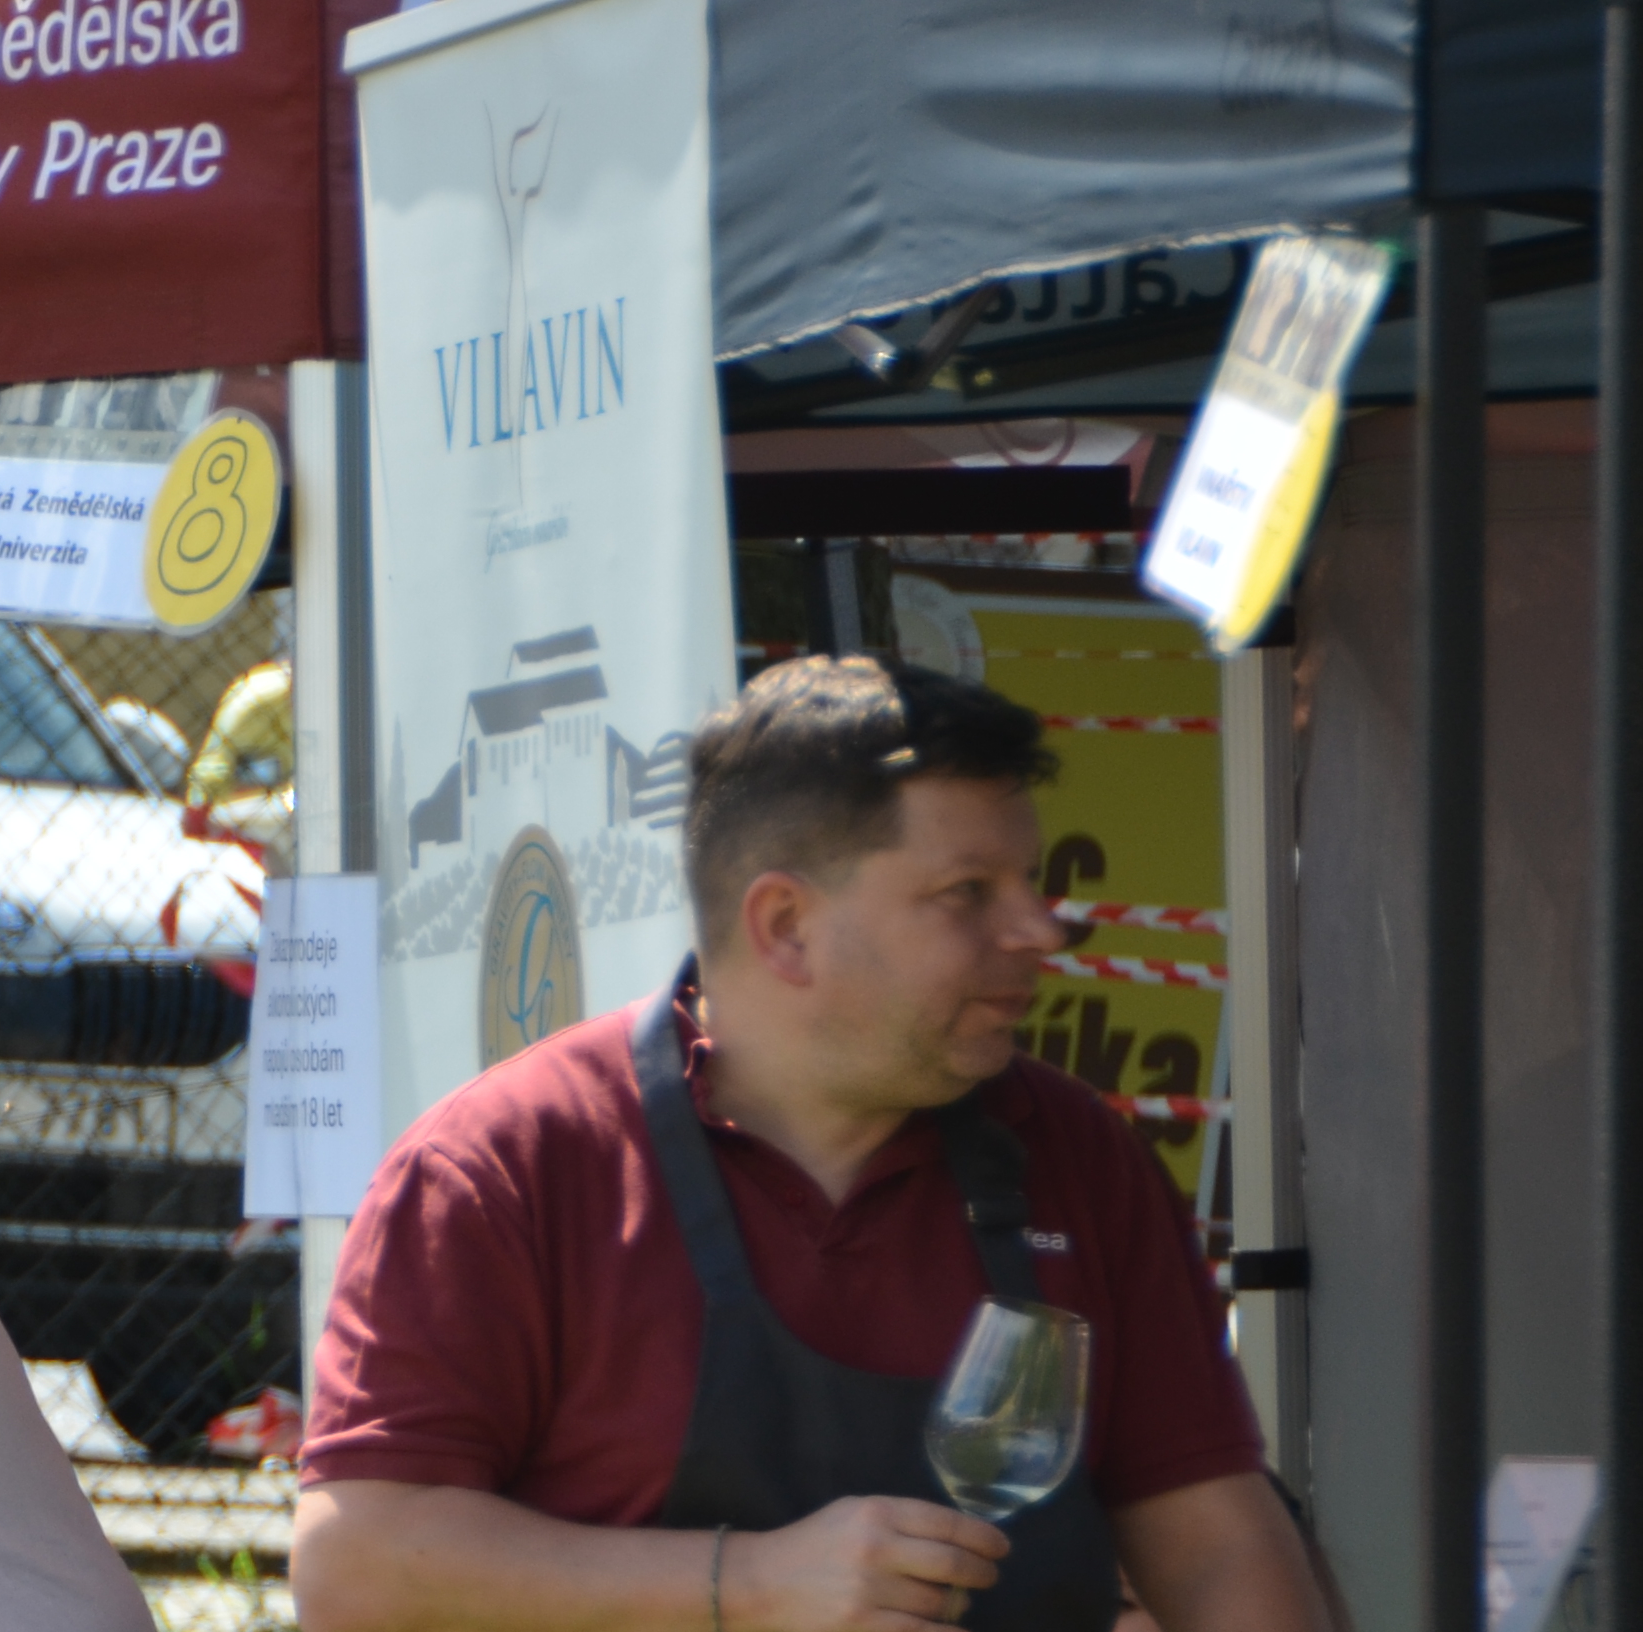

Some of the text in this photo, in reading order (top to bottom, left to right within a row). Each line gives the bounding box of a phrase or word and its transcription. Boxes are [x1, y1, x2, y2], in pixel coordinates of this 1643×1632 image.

[33, 119, 225, 199] Praze
[433, 296, 629, 452] VILAVIN
[22, 488, 145, 523] Zemědělská
[158, 436, 248, 595] 8
[301, 1097, 319, 1128] 18
[322, 1096, 344, 1128] let
